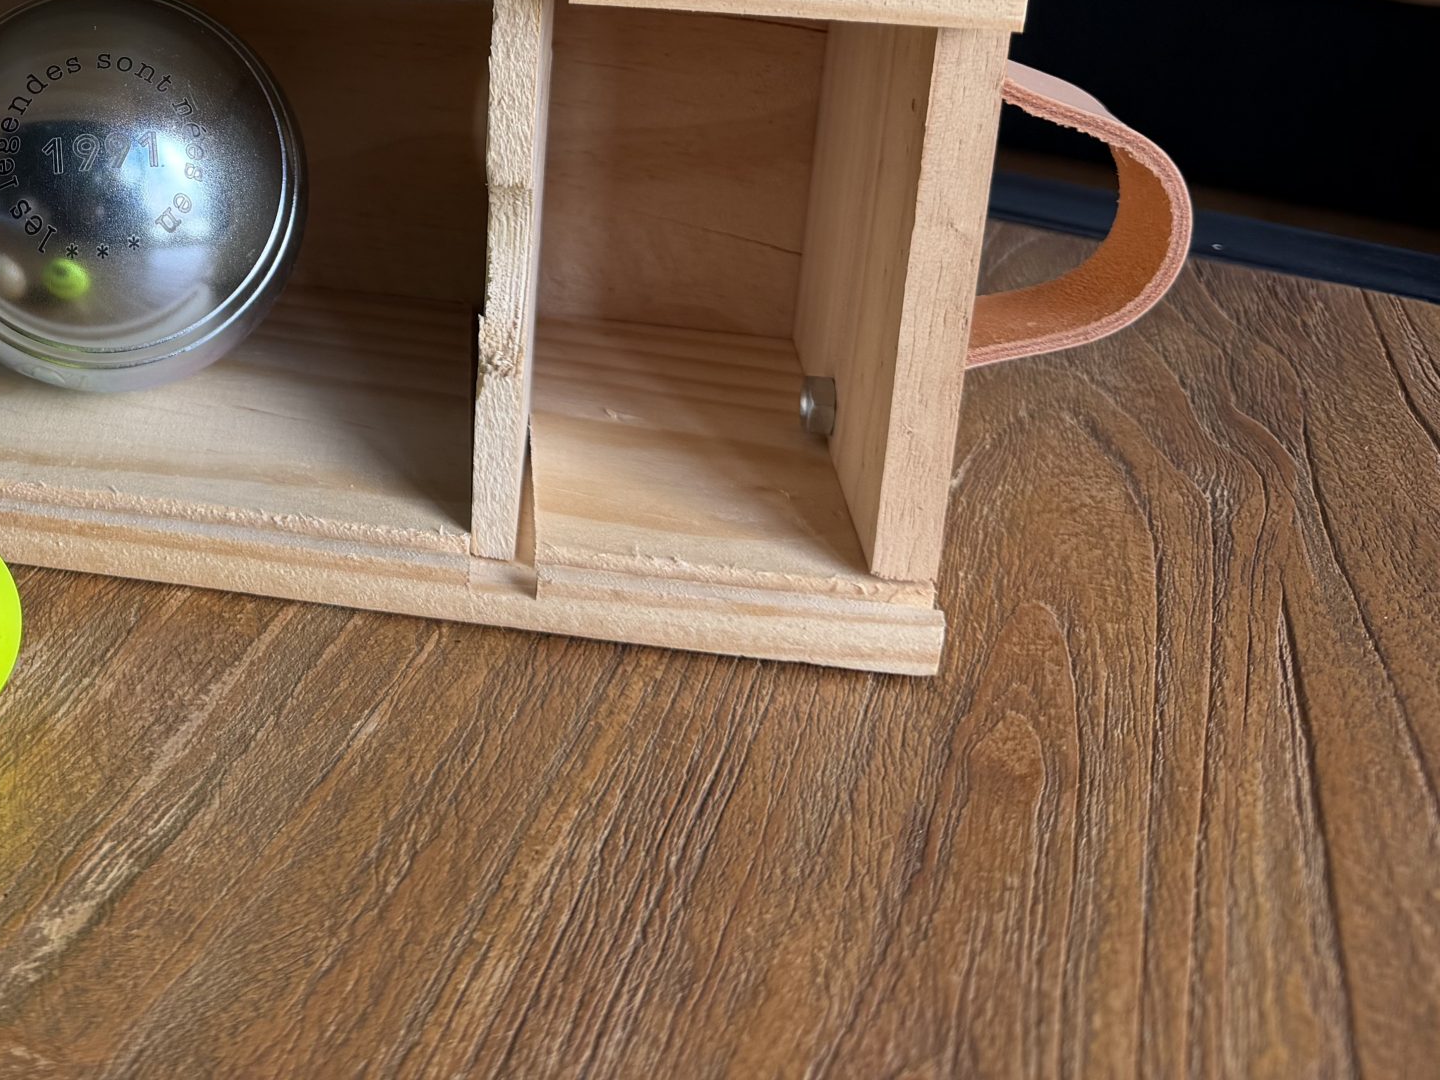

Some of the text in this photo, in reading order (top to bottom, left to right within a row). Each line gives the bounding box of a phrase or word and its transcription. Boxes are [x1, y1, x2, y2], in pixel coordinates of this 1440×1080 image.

[97, 53, 173, 93] sont
[42, 132, 159, 174] 1991
[172, 97, 207, 182] nées
[10, 198, 57, 253] les
[155, 192, 192, 233] en
